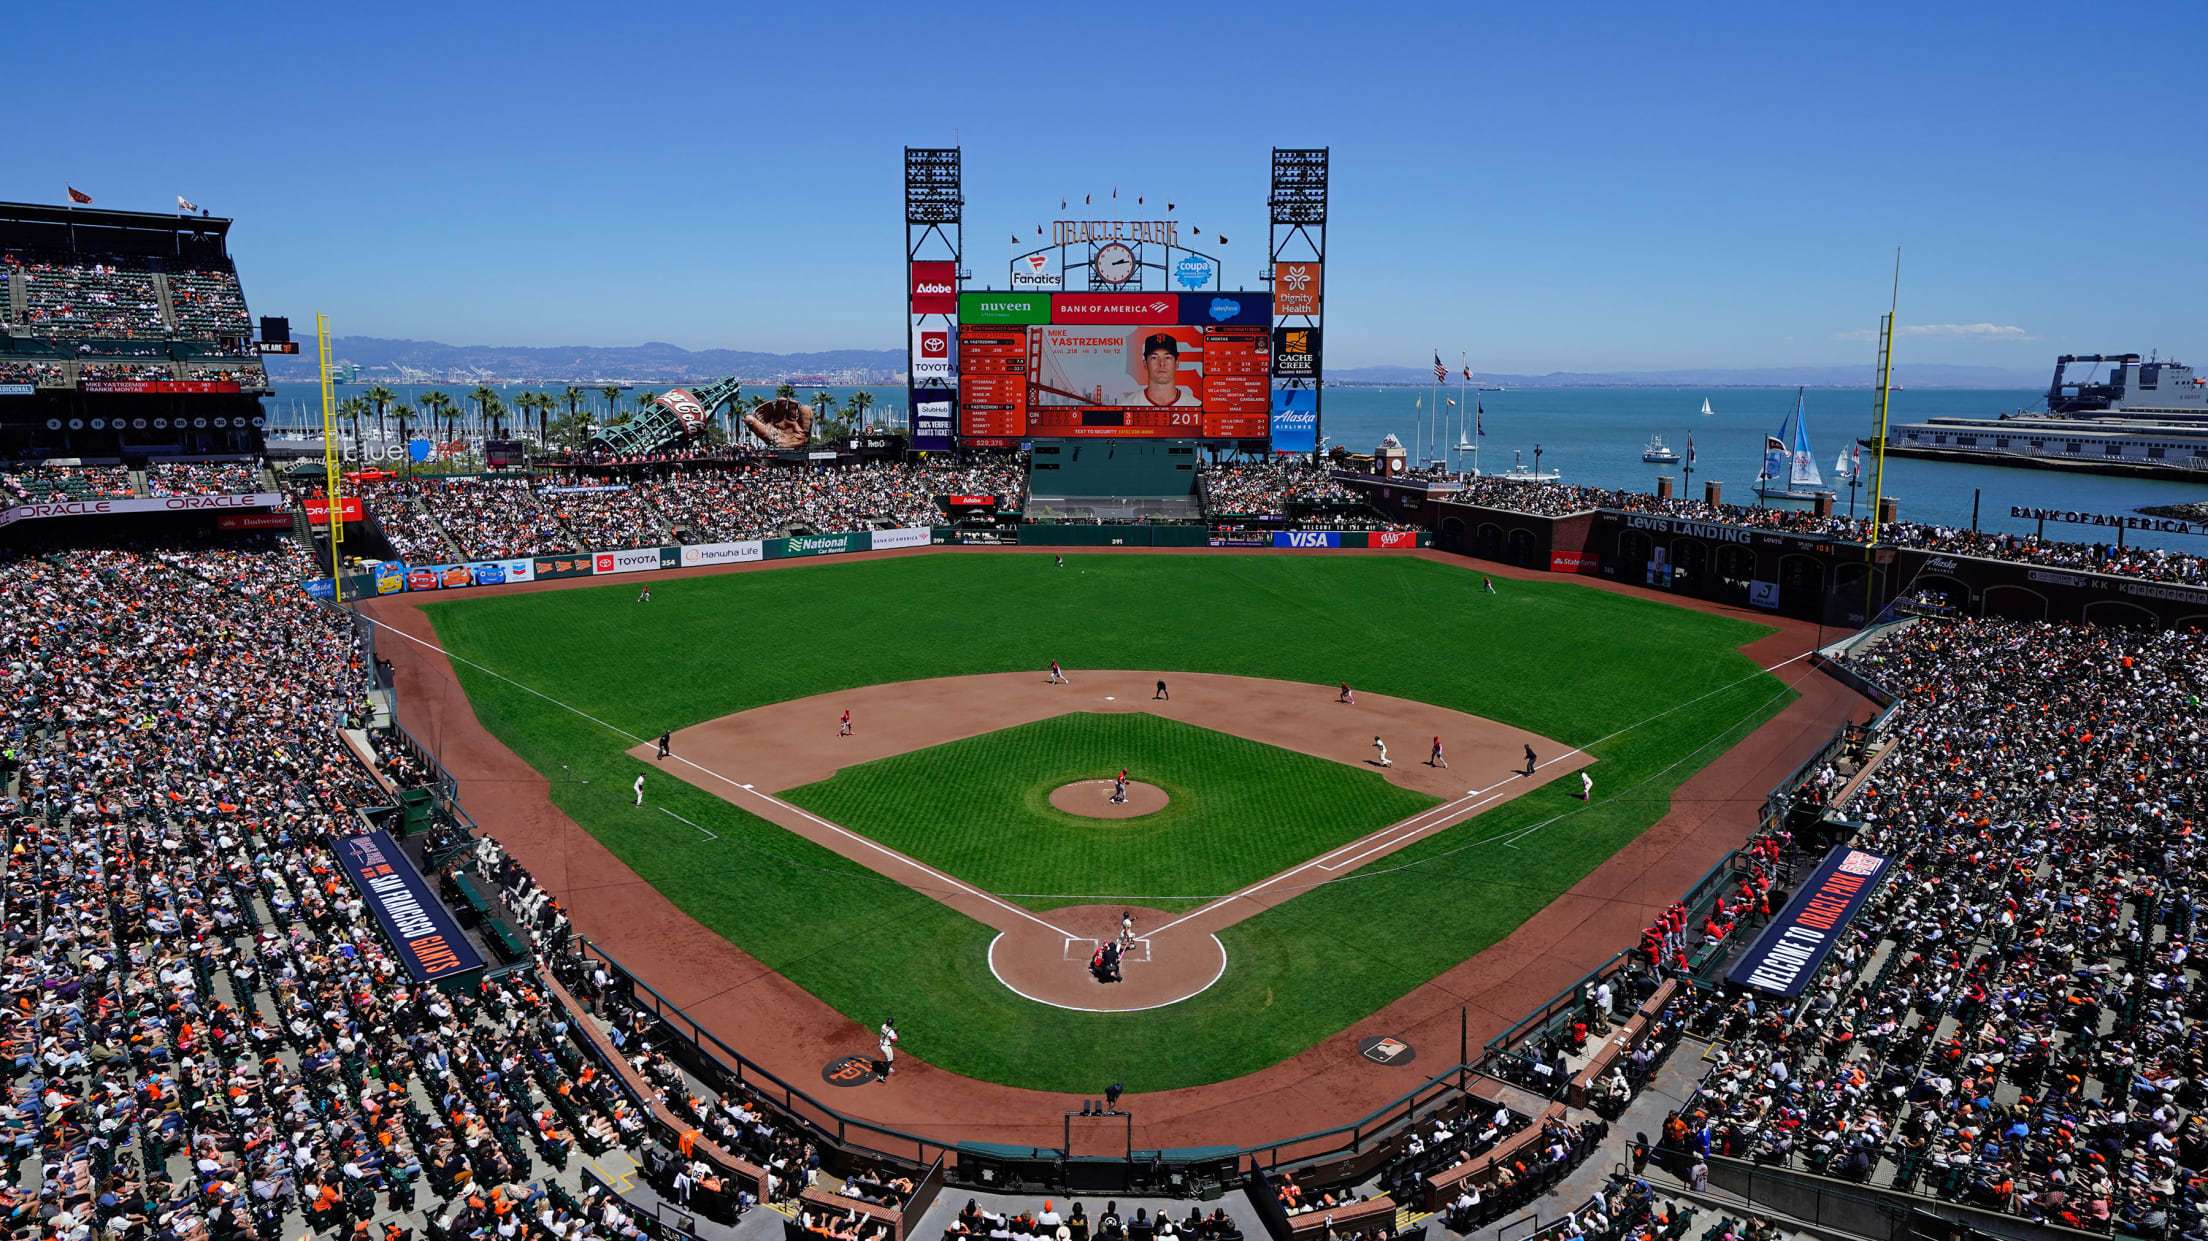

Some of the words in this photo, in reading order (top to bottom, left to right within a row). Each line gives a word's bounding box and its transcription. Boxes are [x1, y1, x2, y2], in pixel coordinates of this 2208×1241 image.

[1053, 221, 1123, 246] ORACLE
[1132, 221, 1179, 247] PARK
[1180, 261, 1209, 273] coupa
[1013, 272, 1062, 285] Fanatics
[916, 283, 952, 293] Adobe
[1280, 294, 1313, 304] Dignity
[980, 303, 1032, 312] nuveen
[1103, 305, 1148, 313] AMERICA
[1281, 304, 1312, 313] Health
[1047, 329, 1067, 337] MIKE
[260, 343, 270, 351] WE
[271, 343, 283, 352] ARE
[1051, 338, 1124, 346] YASTRZEMSKI
[915, 363, 954, 372] TOYOTA
[1273, 409, 1316, 424] Alaska
[166, 496, 255, 509] ORACLE
[20, 502, 111, 518] ORACLE
[243, 518, 288, 526] Budweiser
[2010, 506, 2061, 521] BANK
[2066, 511, 2090, 523] OF
[2093, 514, 2191, 534] AMERICA
[1672, 520, 1752, 544] LANDING
[803, 536, 848, 549] National
[1286, 532, 1328, 547] VISA
[701, 549, 740, 559] Hanwha
[741, 547, 759, 555] Life
[617, 555, 657, 566] TOYOTA
[1925, 556, 1959, 569] Alaska
[368, 874, 406, 894] SAN
[1821, 871, 1866, 897] PARK
[378, 889, 438, 939] FRANCISCO
[1795, 893, 1850, 930] ORACLE
[1784, 926, 1825, 944] TO
[409, 935, 463, 973] GIANTS
[1747, 939, 1816, 992] WELCOME
